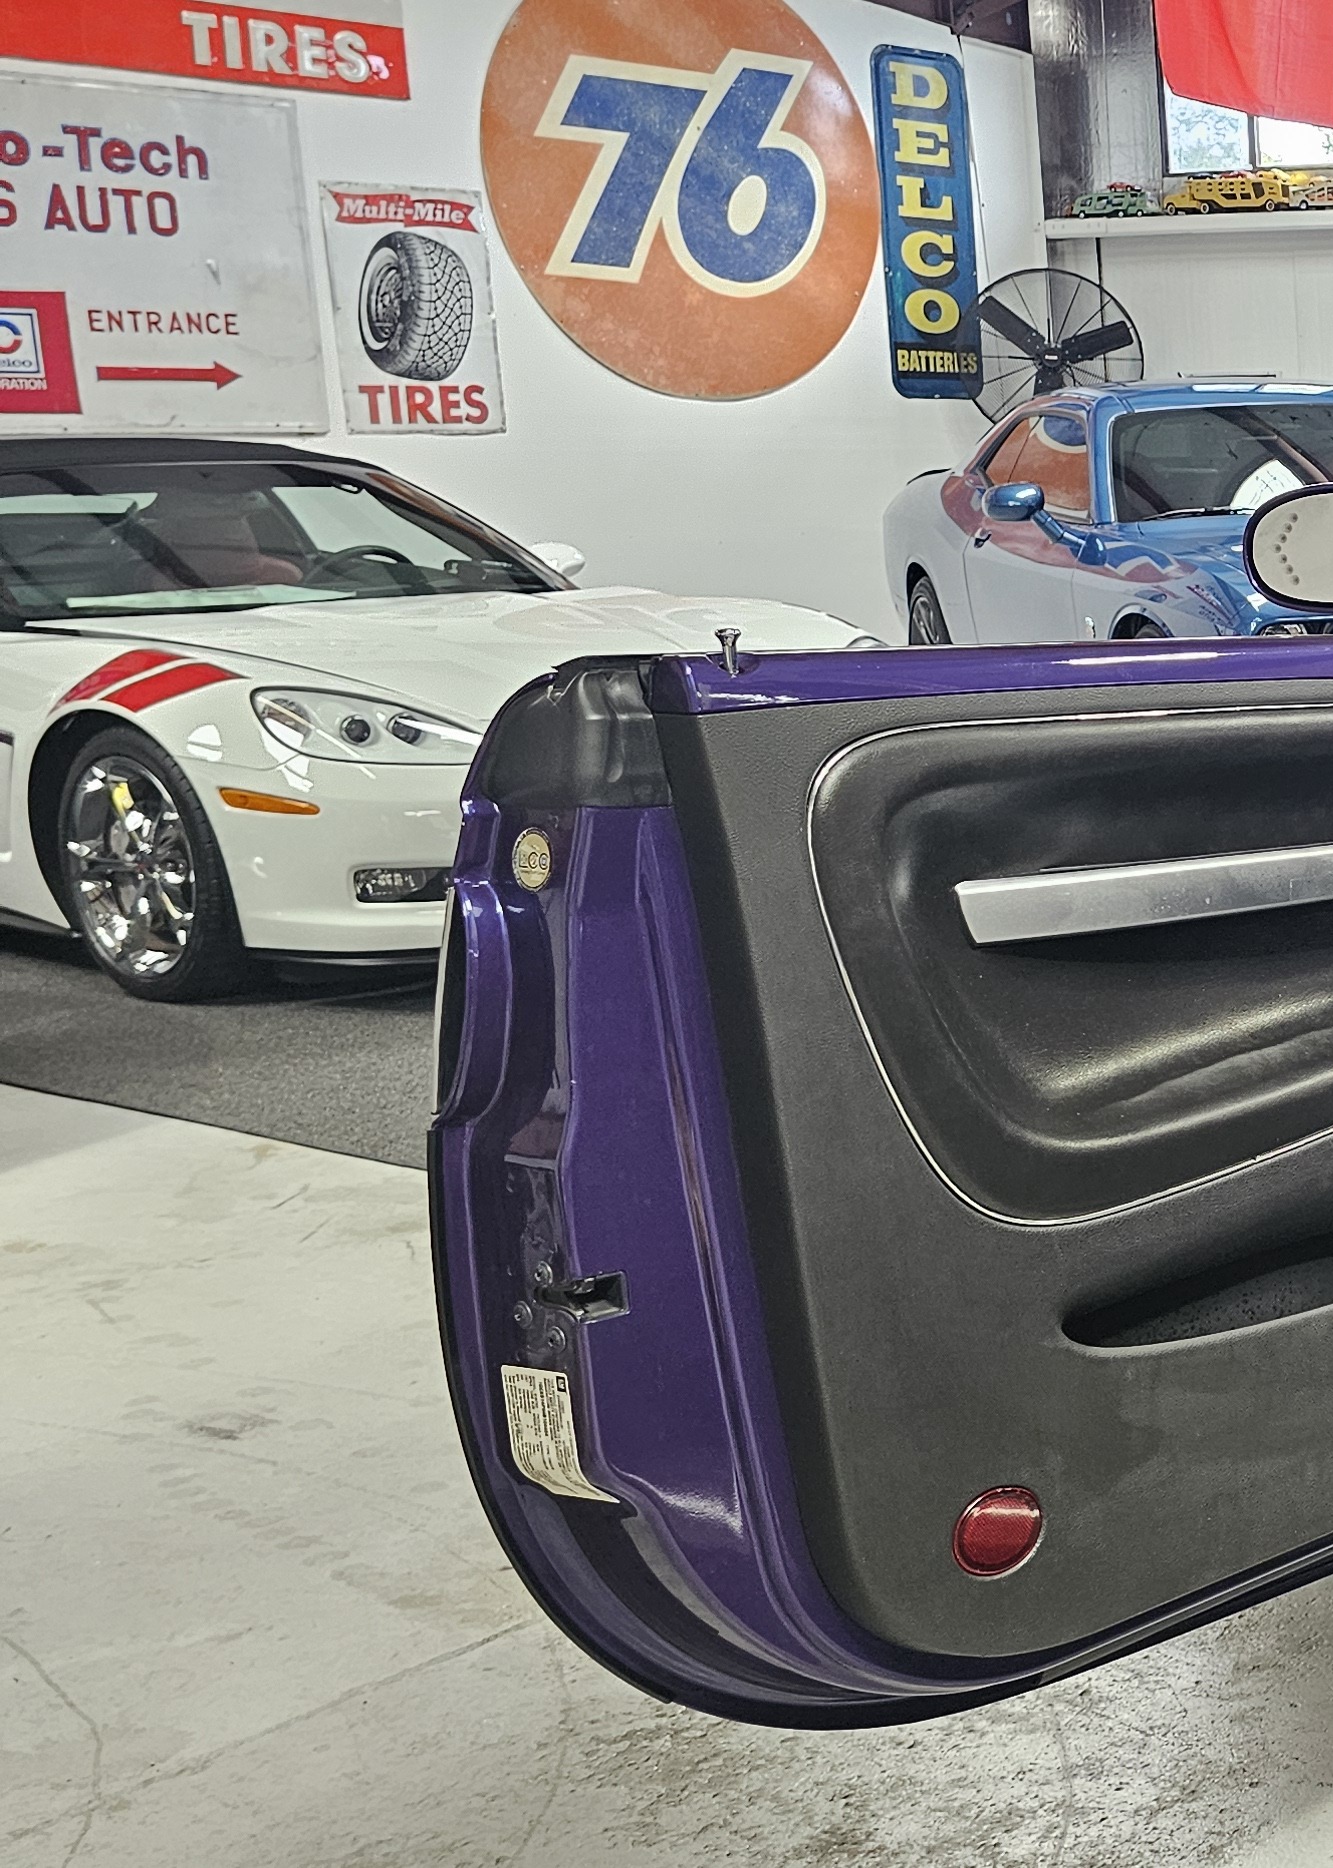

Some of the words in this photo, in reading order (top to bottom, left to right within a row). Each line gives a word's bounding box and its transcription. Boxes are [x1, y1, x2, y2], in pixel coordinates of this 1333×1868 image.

[180, 10, 373, 83] TIRES
[535, 48, 827, 298] 76
[44, 183, 179, 237] AUTO
[341, 197, 466, 224] Multi-Mile
[888, 61, 961, 334] DELCO
[88, 309, 241, 336] ENTRANCE
[897, 348, 978, 374] BATTERIES
[358, 384, 490, 425] TIRES
